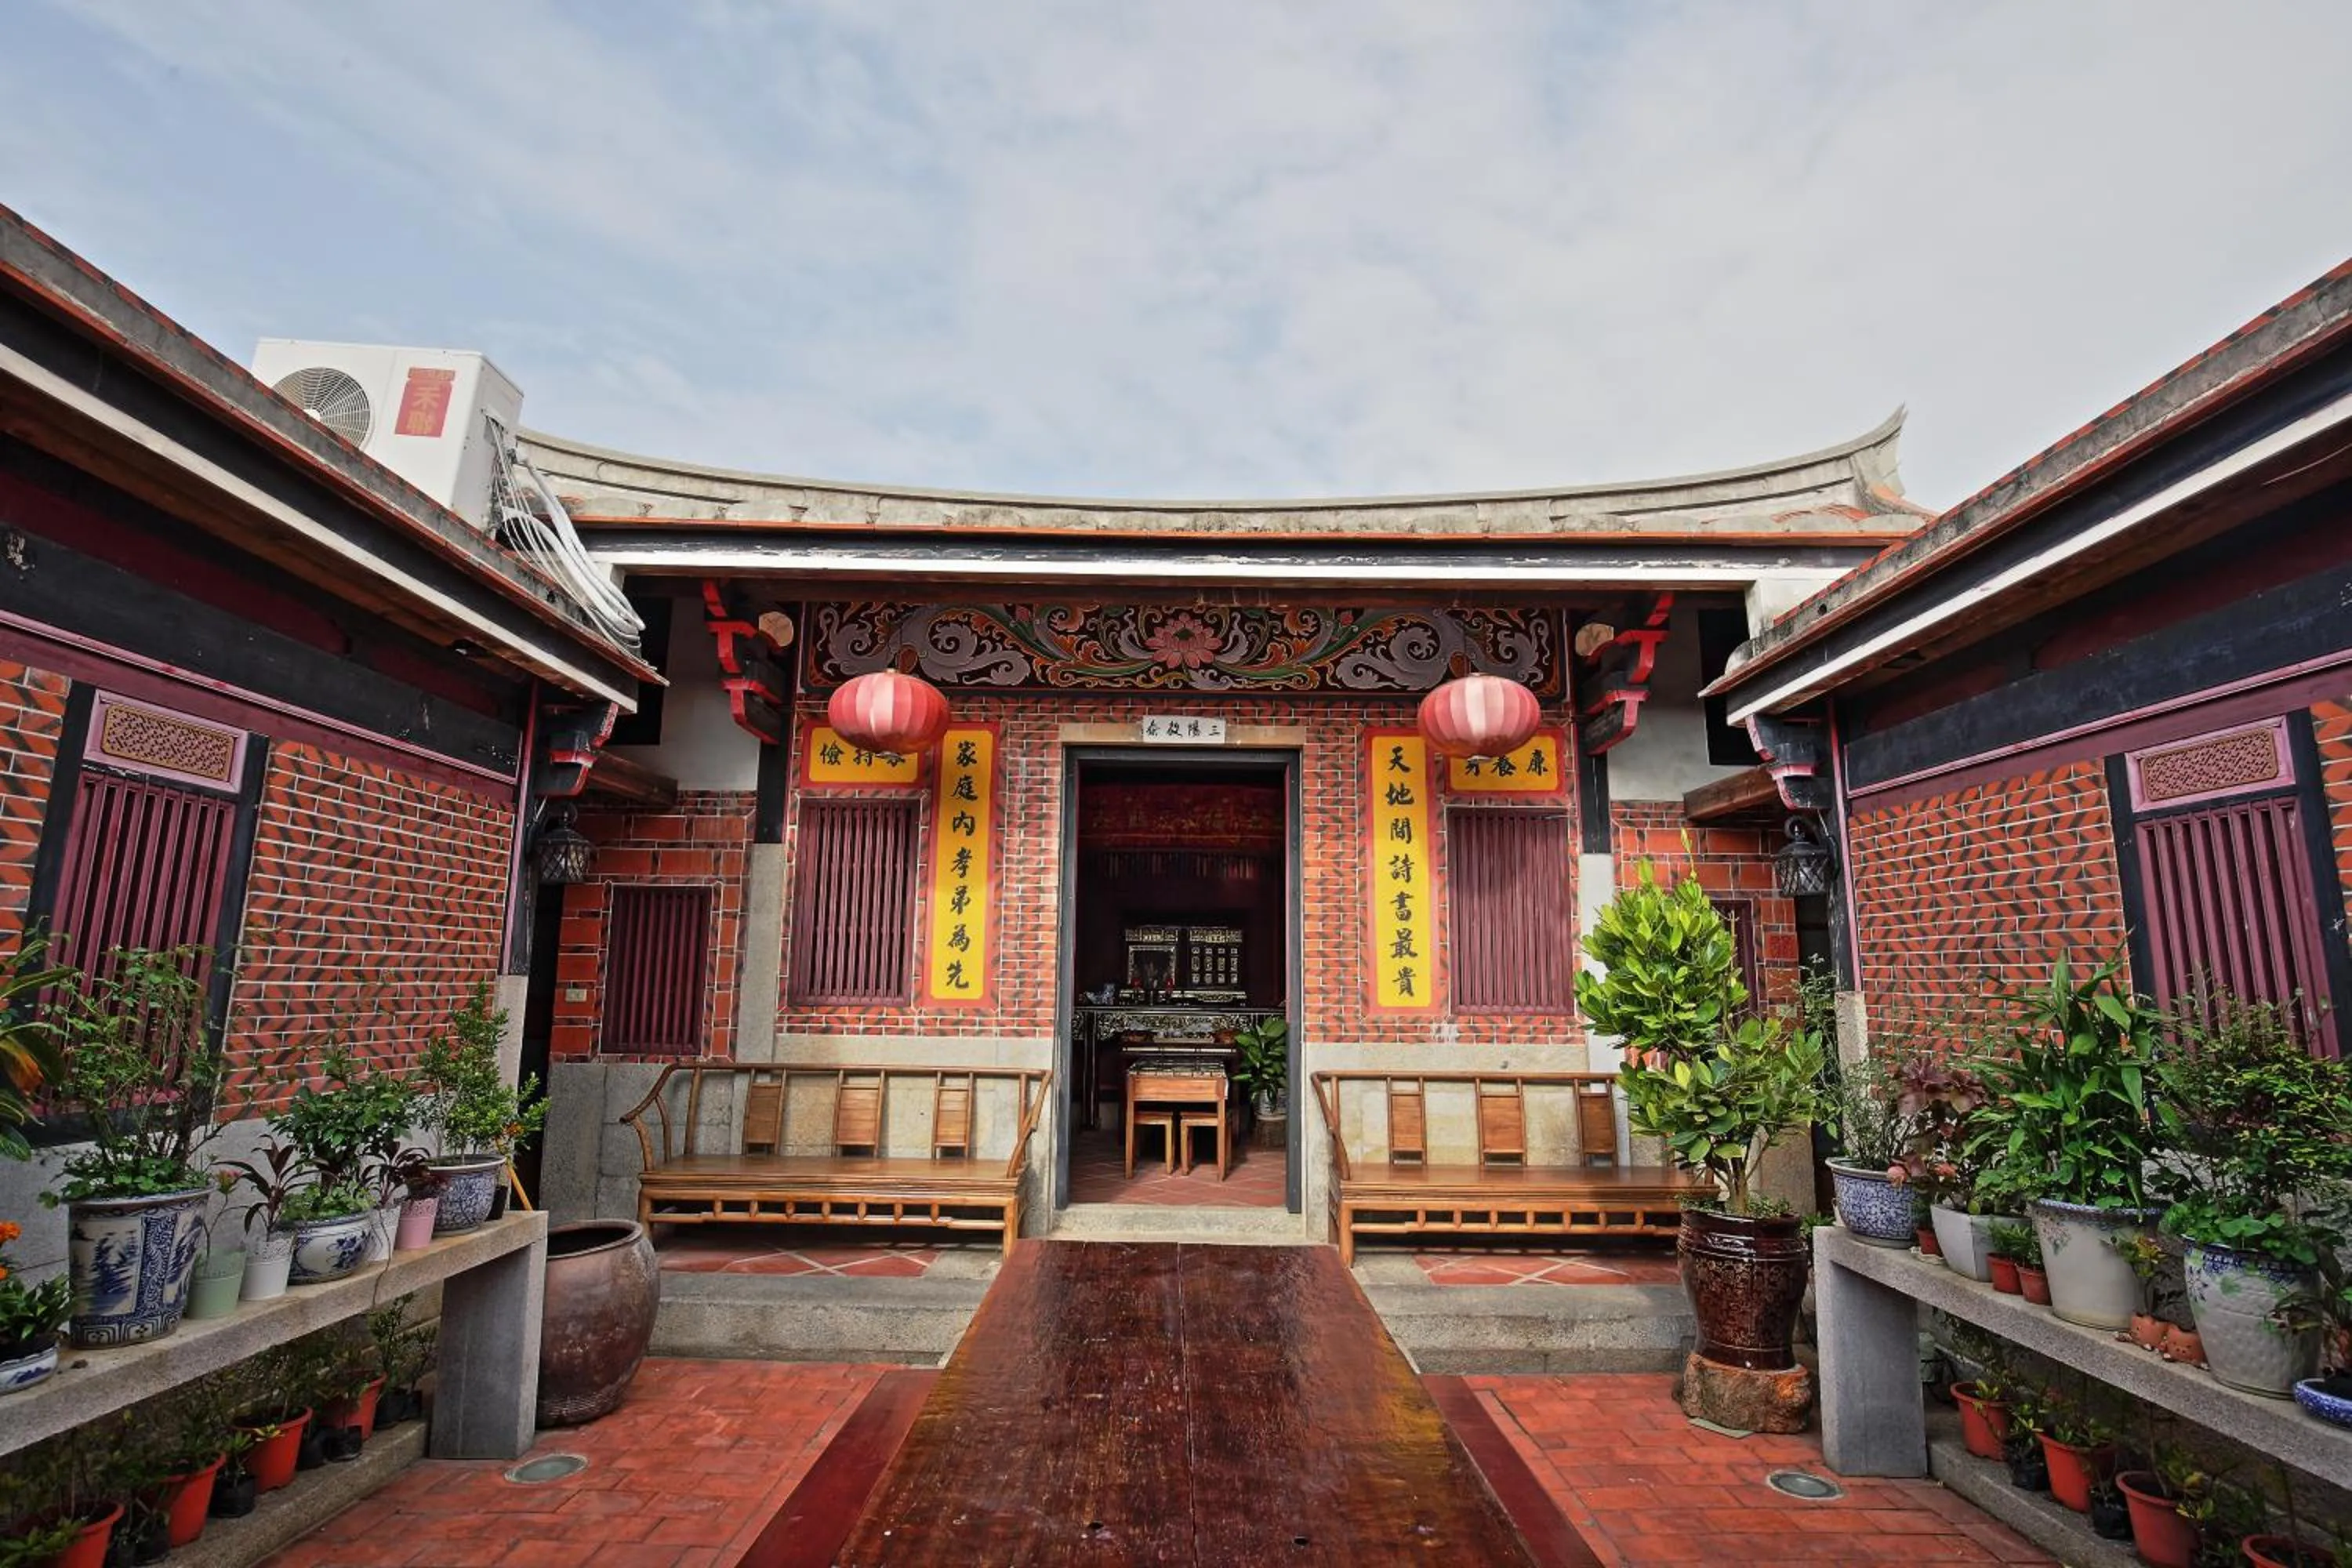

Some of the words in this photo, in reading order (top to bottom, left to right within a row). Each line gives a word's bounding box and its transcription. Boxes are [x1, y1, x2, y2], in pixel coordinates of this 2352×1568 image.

[1385, 746, 1417, 996] 天地間詩書最貴
